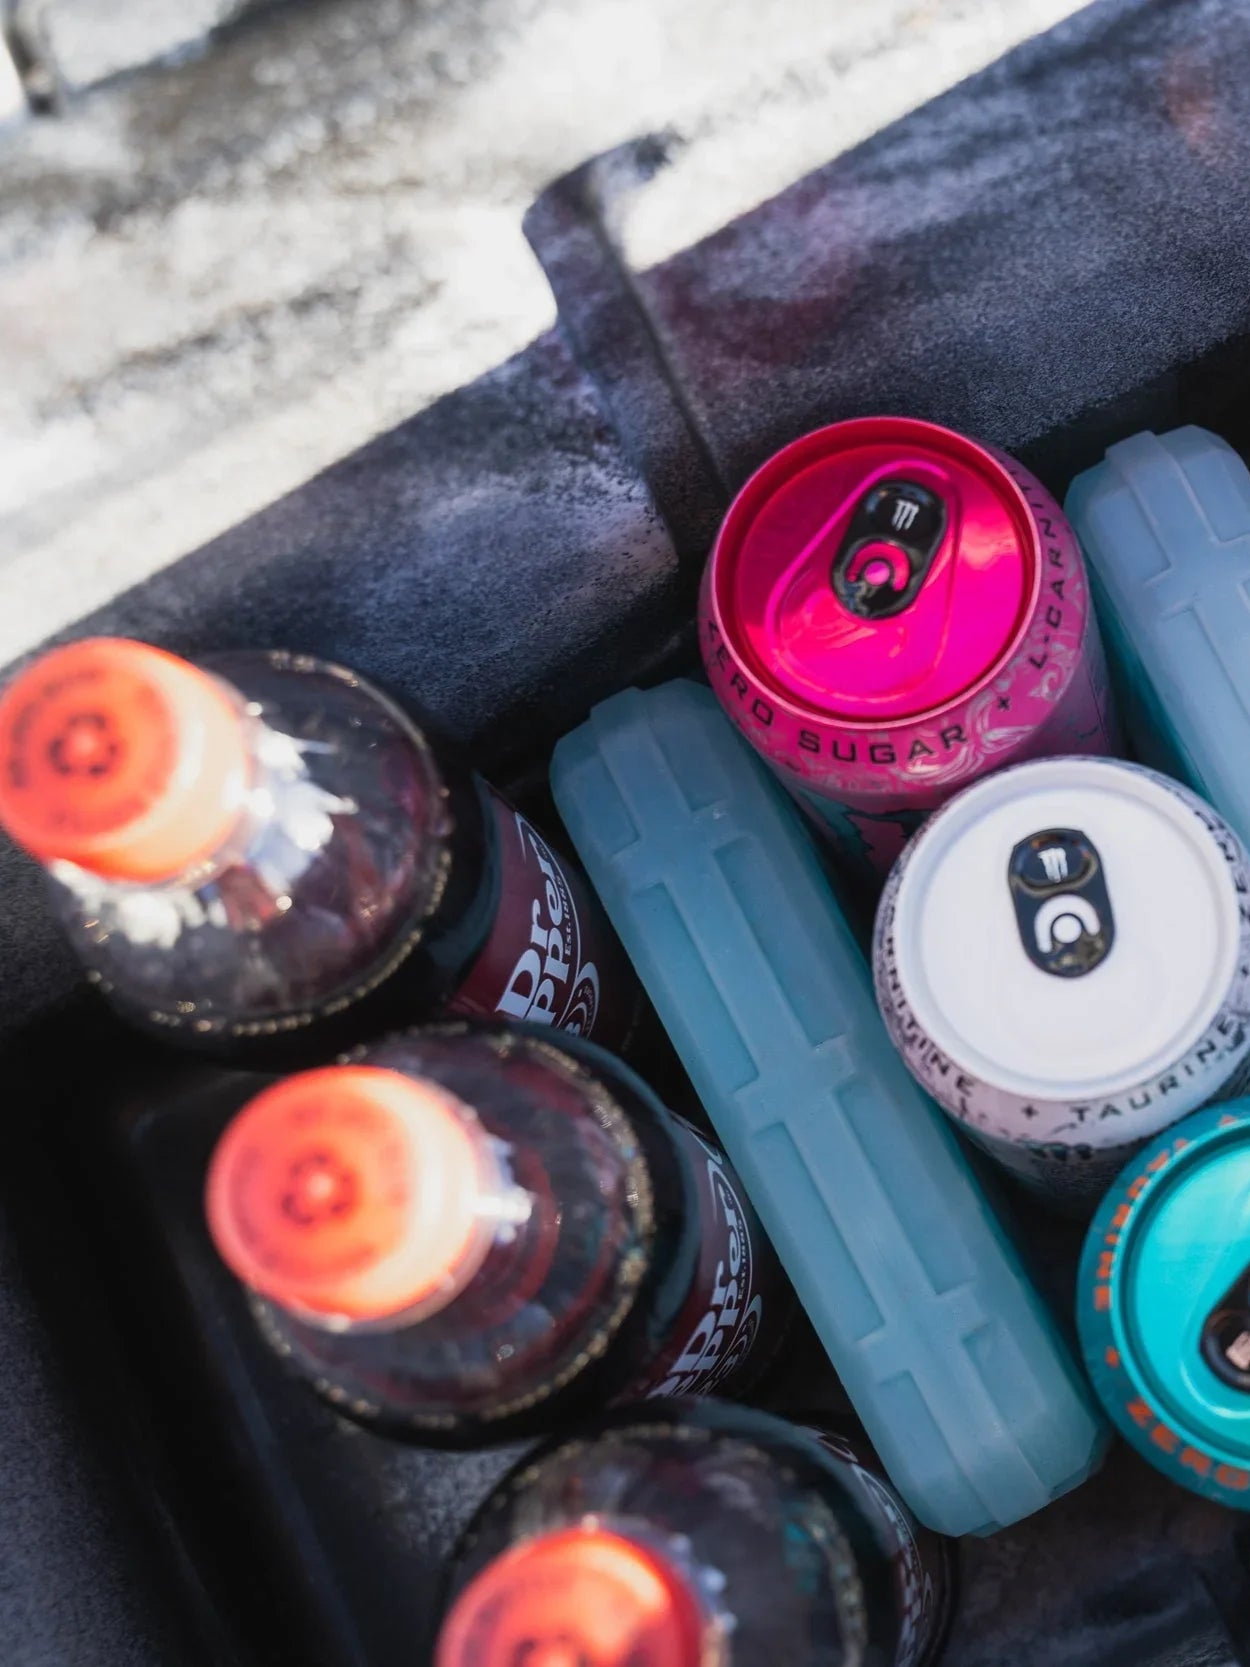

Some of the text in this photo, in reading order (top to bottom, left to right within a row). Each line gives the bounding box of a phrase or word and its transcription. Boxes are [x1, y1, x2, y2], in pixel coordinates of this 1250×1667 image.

[798, 723, 968, 765] SUGAR
[495, 898, 550, 1020] Dr
[1070, 1015, 1236, 1122] TAURINE
[668, 1259, 728, 1373] Dr
